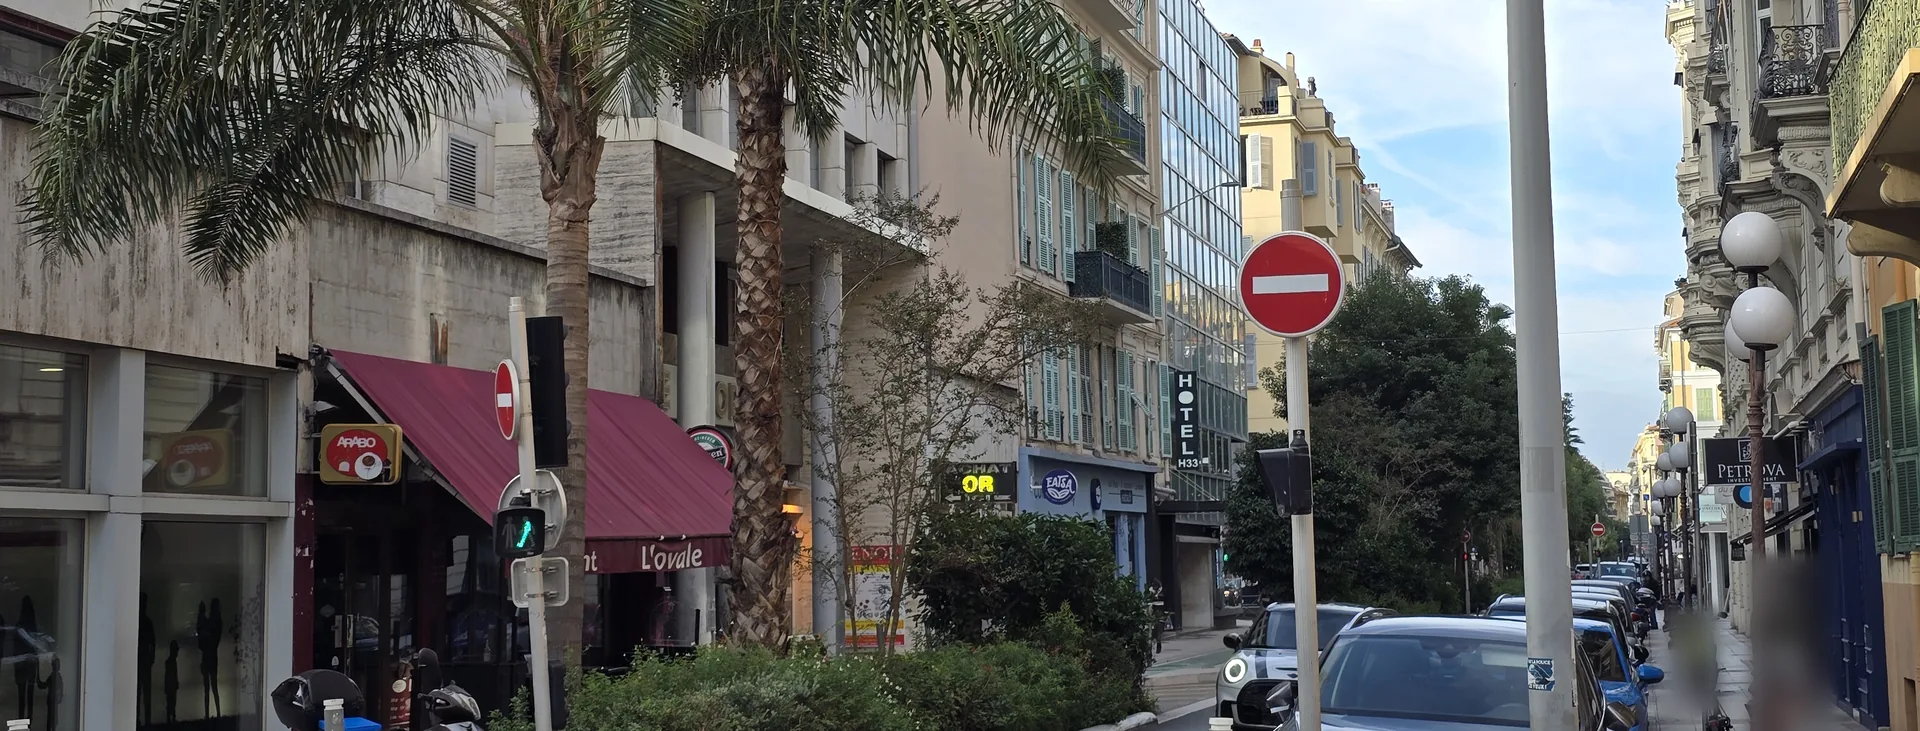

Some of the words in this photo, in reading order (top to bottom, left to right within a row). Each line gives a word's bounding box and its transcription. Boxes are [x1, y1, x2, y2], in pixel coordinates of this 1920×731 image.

[1178, 374, 1194, 455] HOTEL
[337, 436, 376, 448] ARABO
[1718, 464, 1785, 478] PETRVA
[962, 475, 994, 493] OR
[1046, 475, 1075, 494] EATSA
[641, 542, 703, 570] L'ovale
